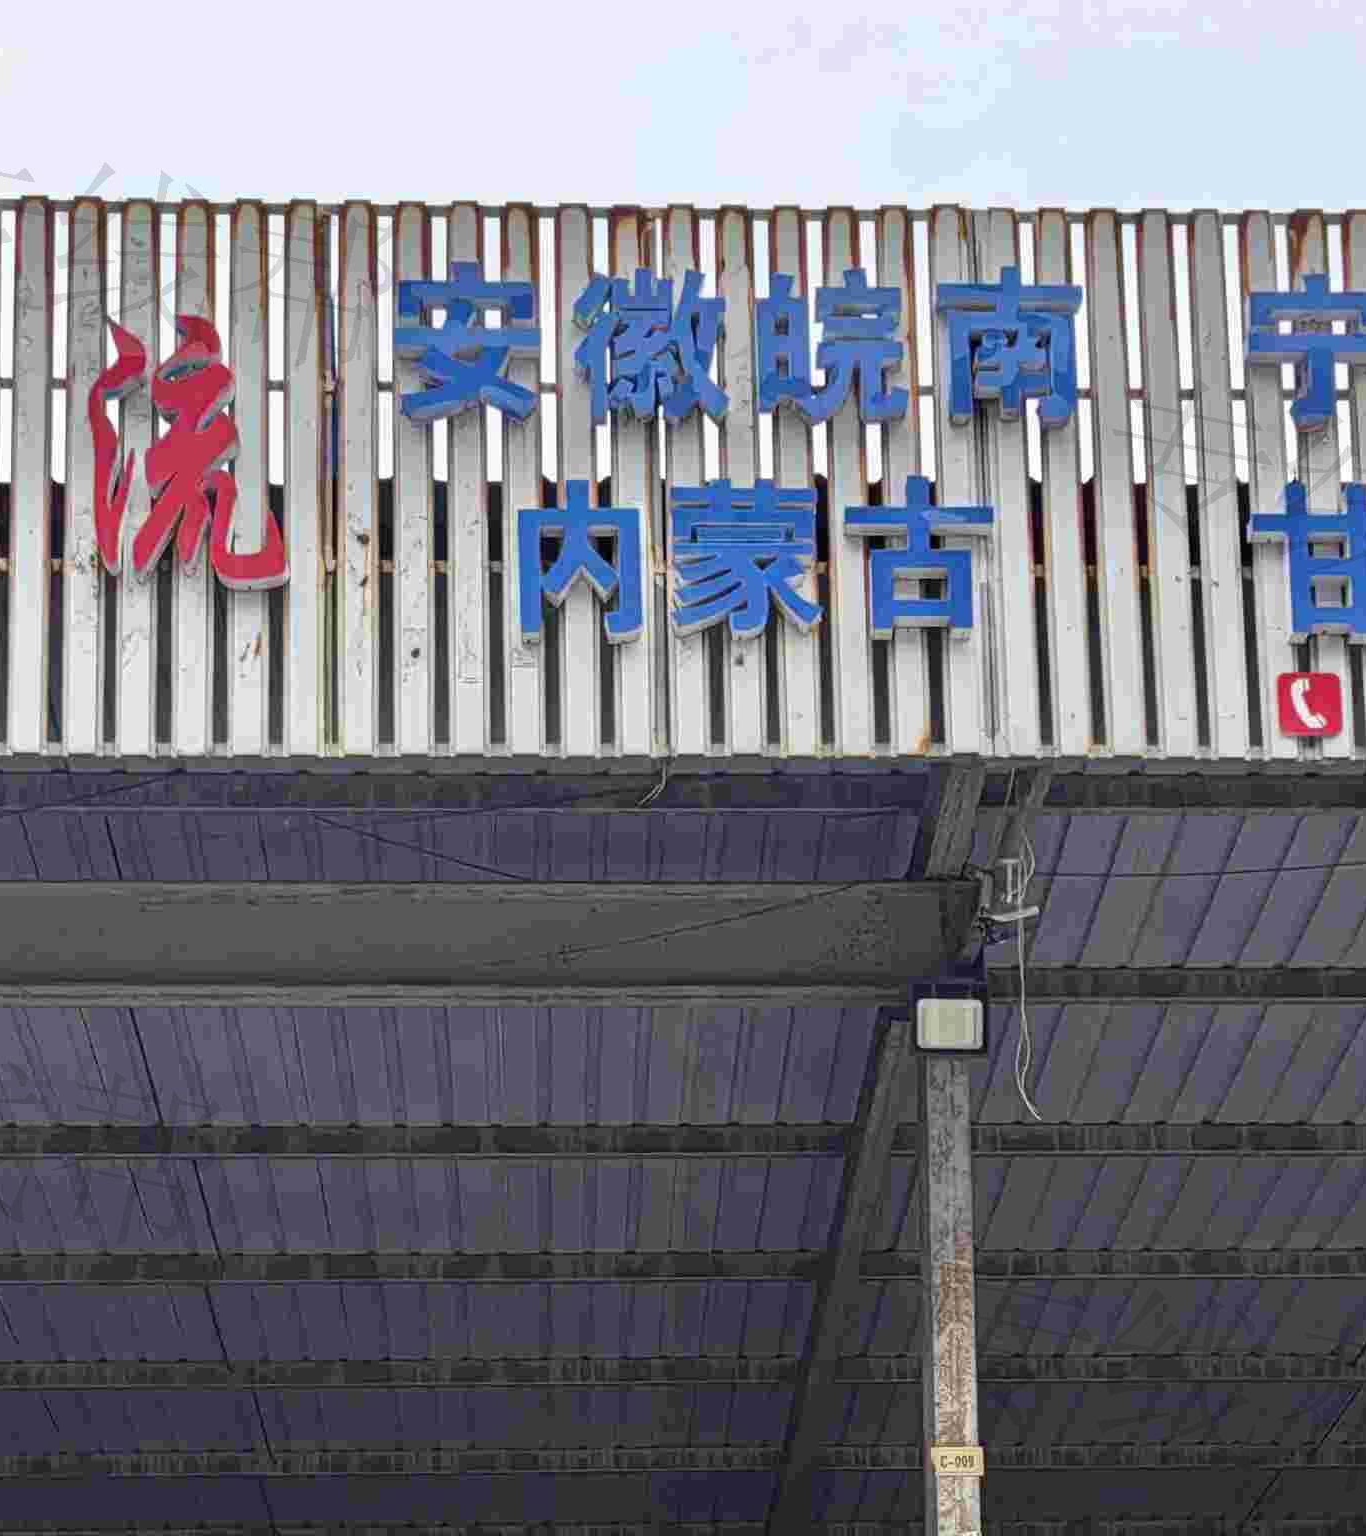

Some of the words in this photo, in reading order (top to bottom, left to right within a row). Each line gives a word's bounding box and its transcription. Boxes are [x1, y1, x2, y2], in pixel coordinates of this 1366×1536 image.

[393, 262, 1084, 428] 安徽皖南
[517, 475, 993, 642] 内蒙古
